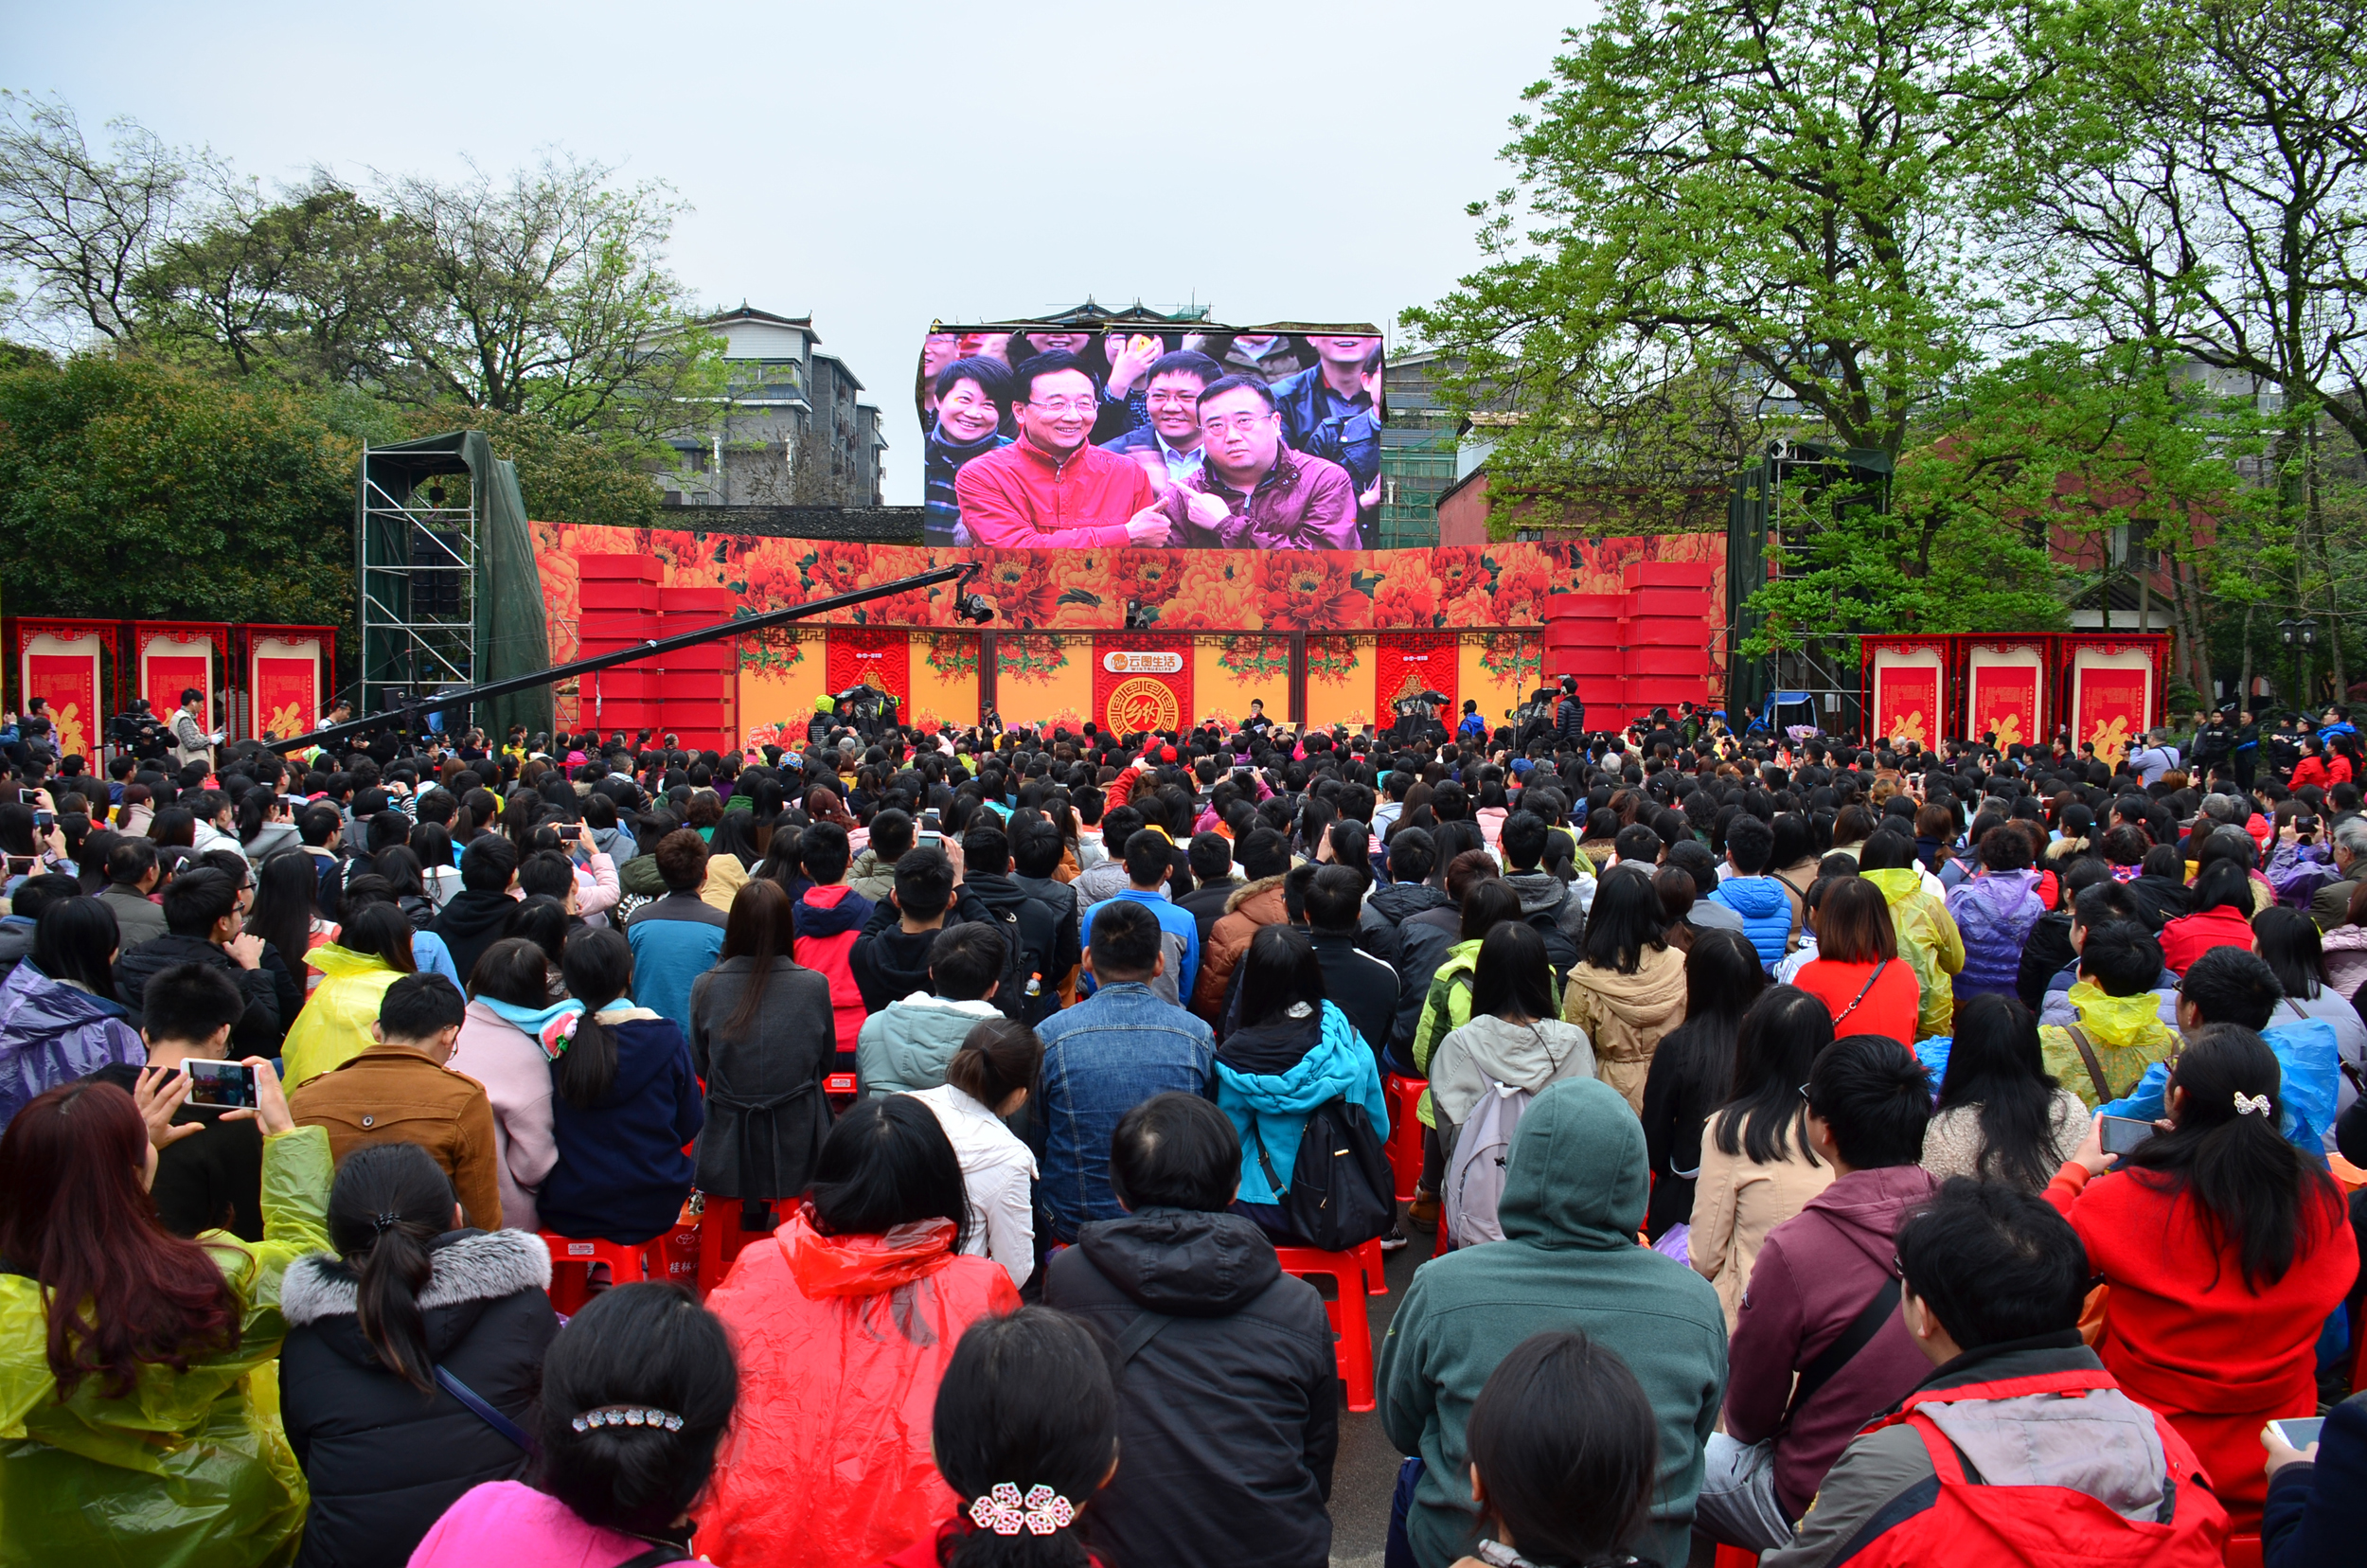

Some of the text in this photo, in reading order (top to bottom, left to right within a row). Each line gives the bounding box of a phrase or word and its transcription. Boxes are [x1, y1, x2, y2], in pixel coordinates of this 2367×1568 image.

[1129, 655, 1176, 668] 云图生活
[1126, 700, 1160, 725] 乡约
